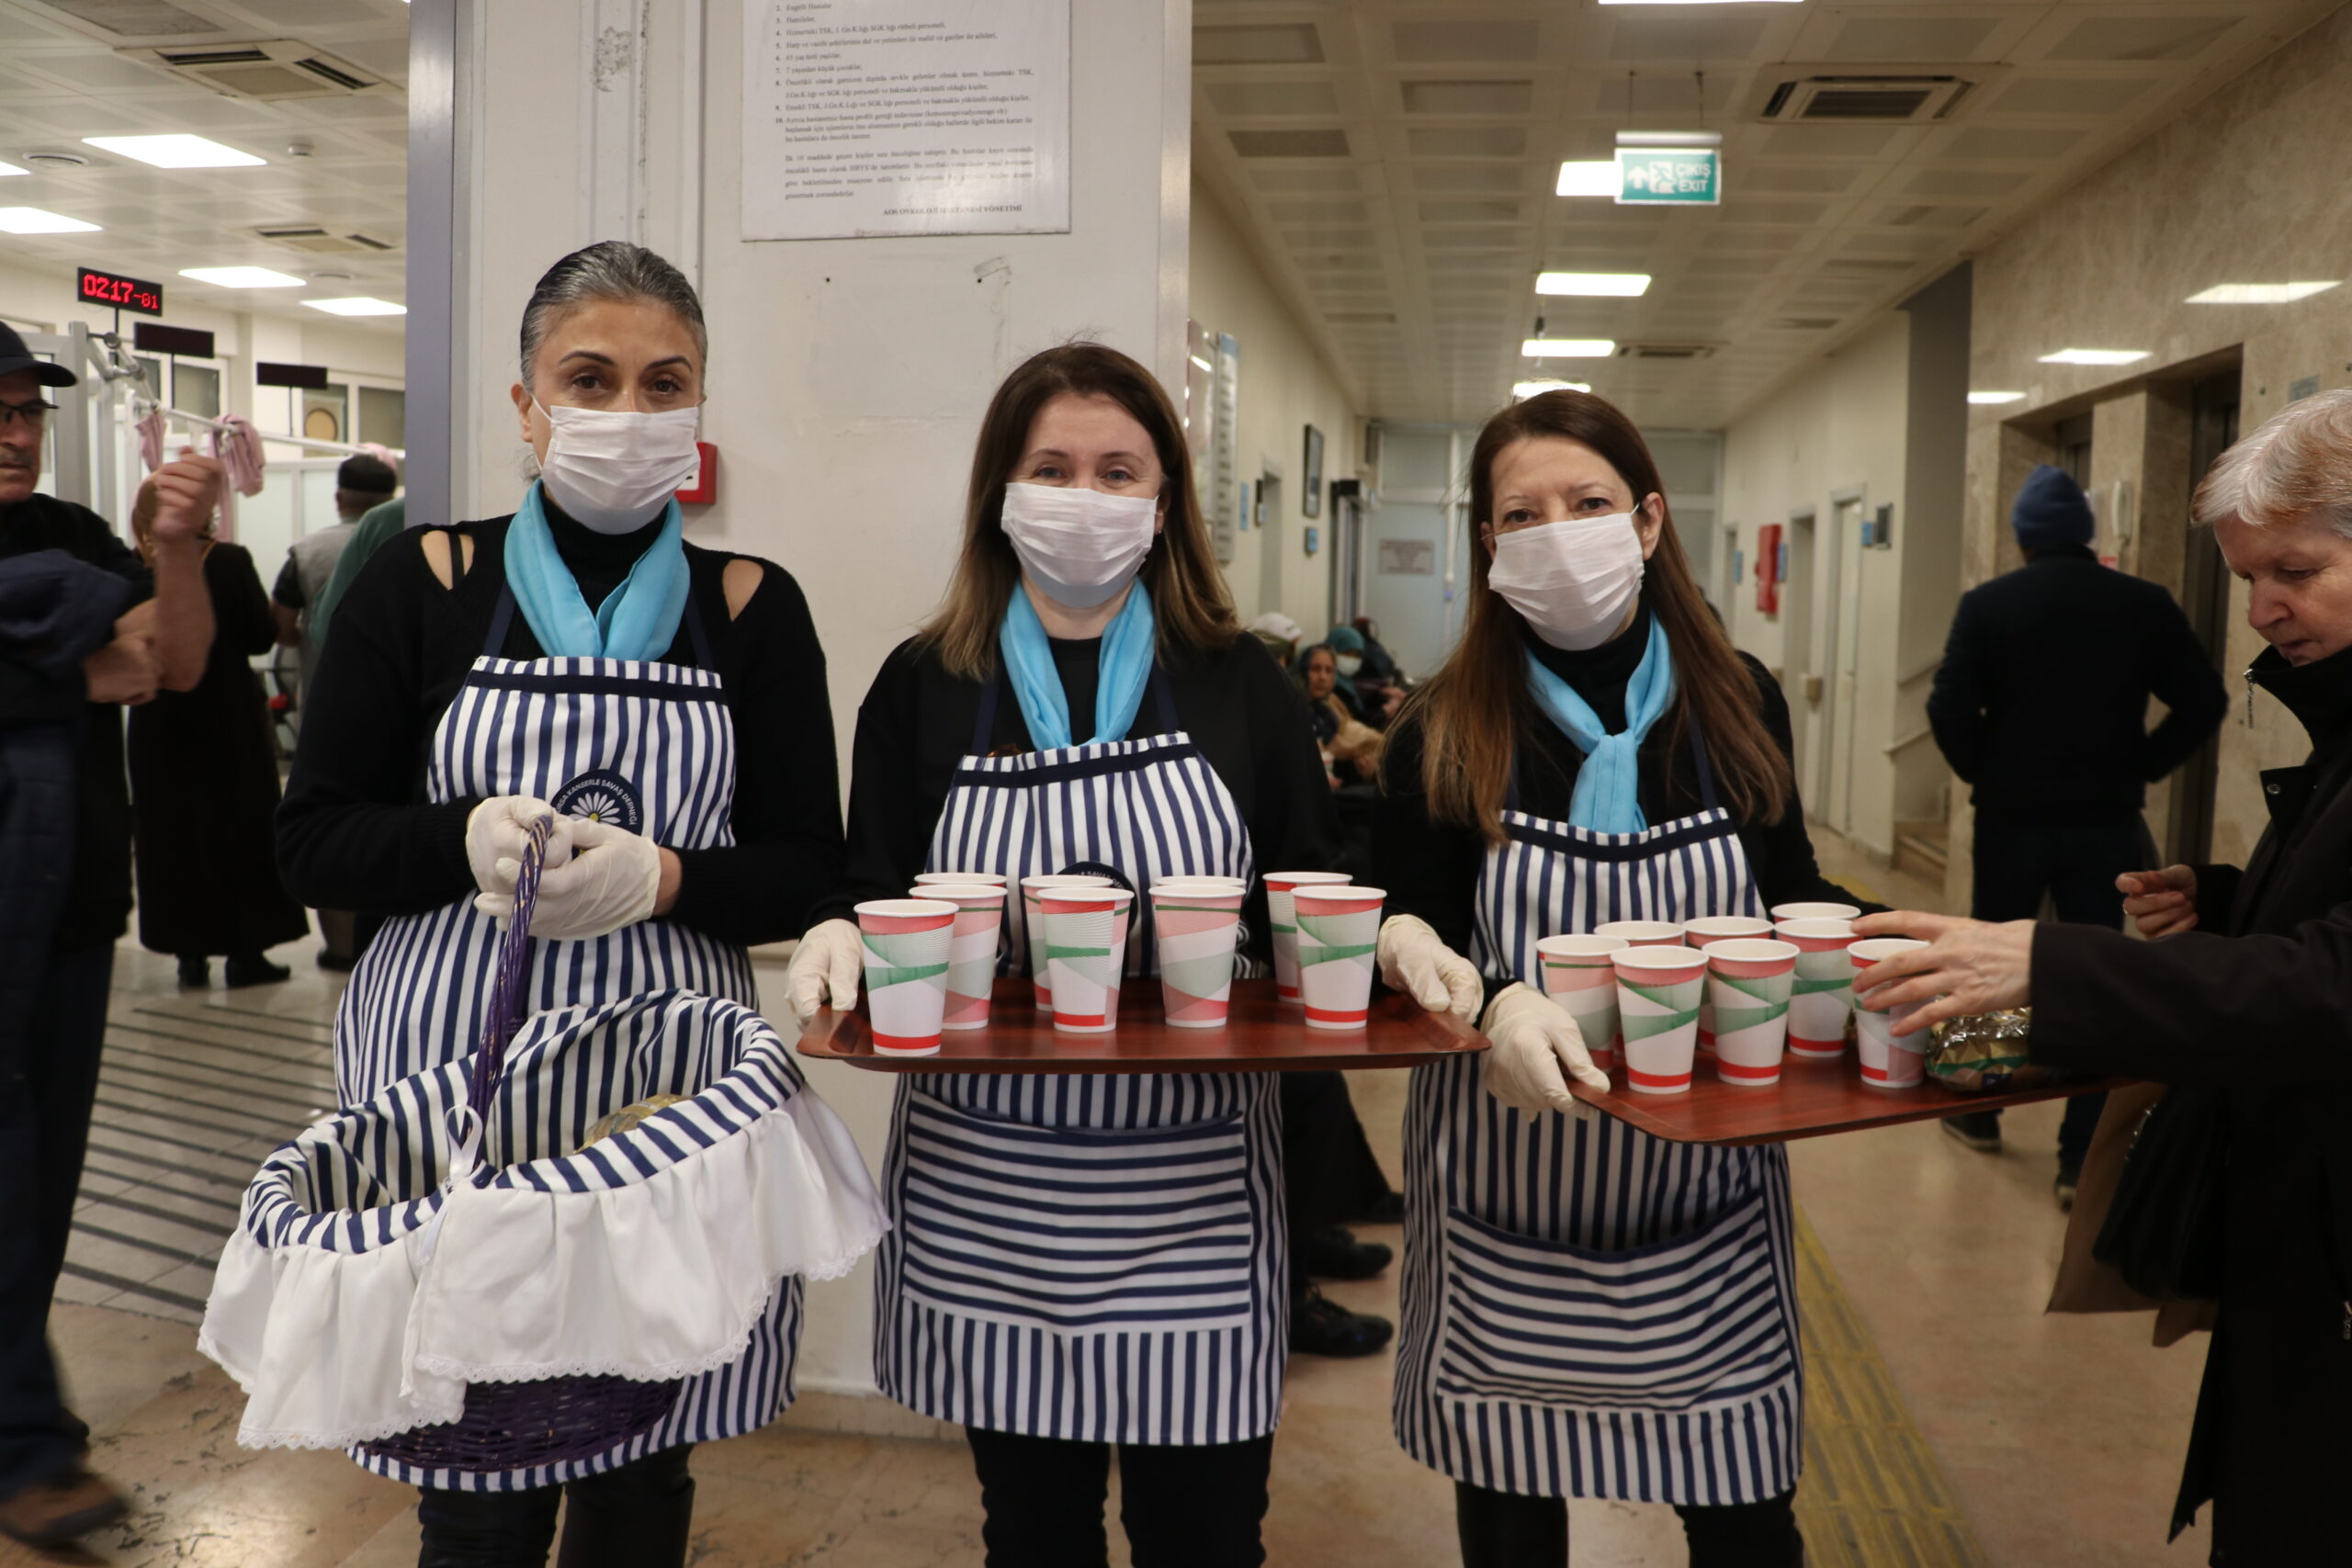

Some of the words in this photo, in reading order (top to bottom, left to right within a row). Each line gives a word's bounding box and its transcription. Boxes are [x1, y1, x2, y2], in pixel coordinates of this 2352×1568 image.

[1676, 163, 1712, 178] ÇIKIŞ
[1679, 180, 1708, 192] EXIT
[567, 778, 601, 796] KANSERLE
[601, 779, 624, 796] SAVAŞ
